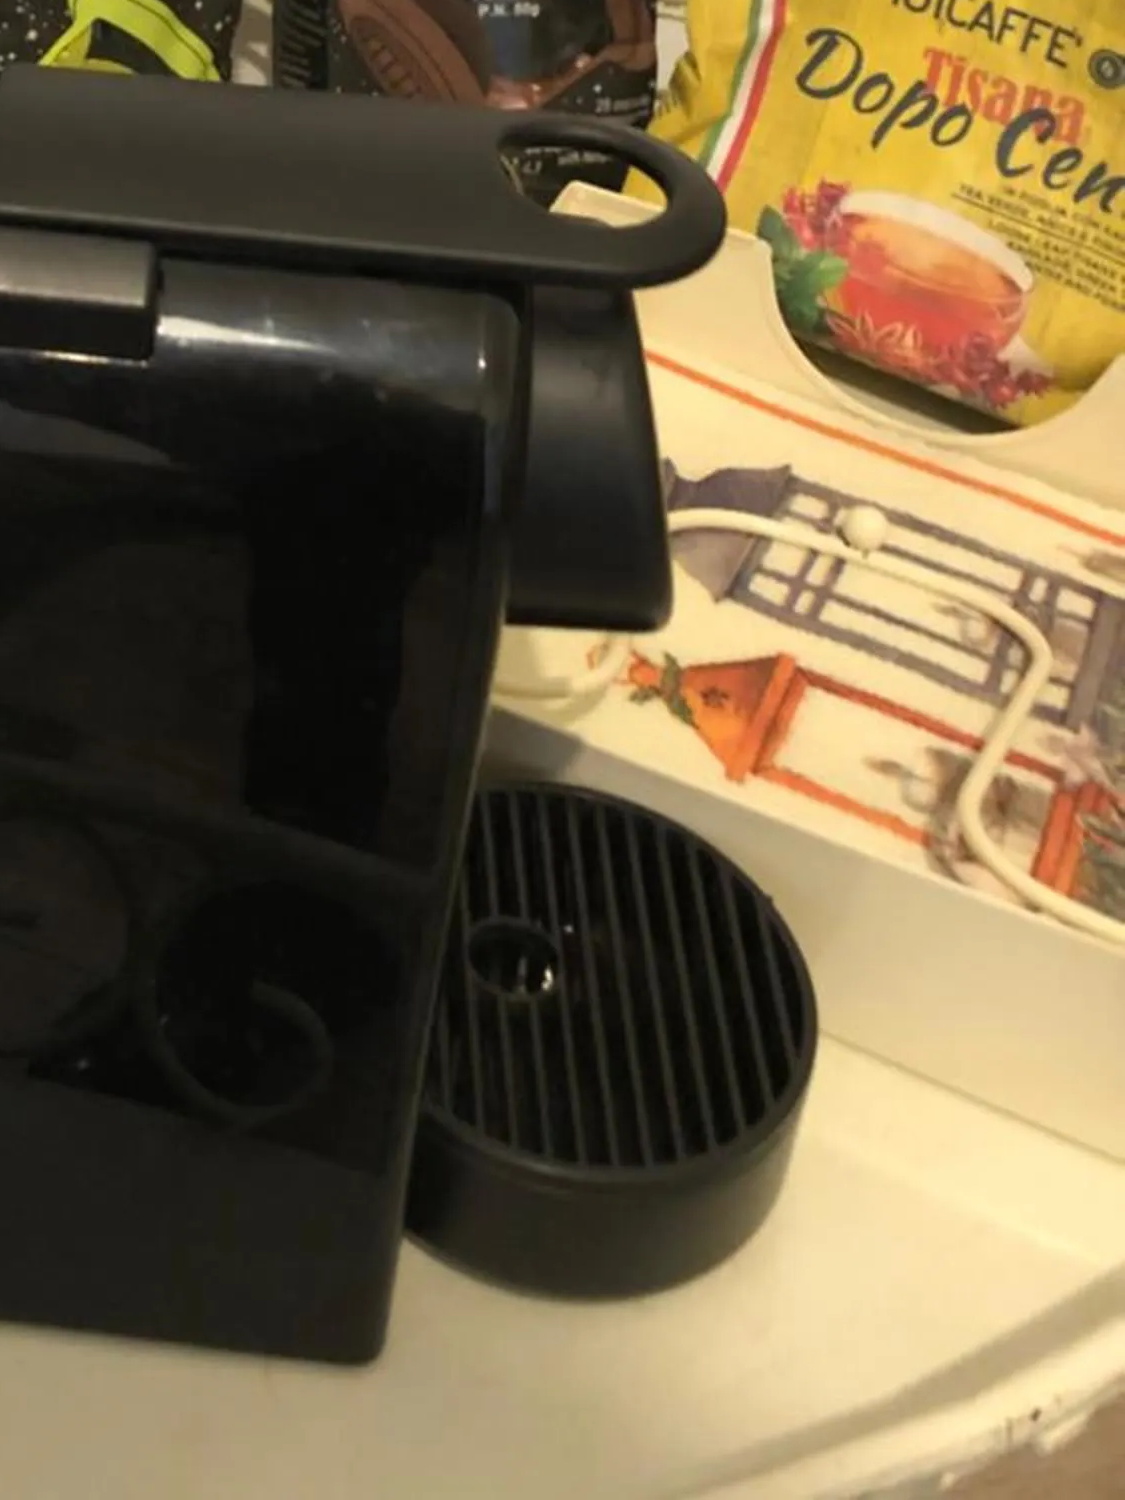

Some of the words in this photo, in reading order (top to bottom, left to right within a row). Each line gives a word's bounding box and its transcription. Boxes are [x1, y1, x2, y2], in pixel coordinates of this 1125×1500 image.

[795, 27, 974, 150] Dopo
[994, 107, 1125, 214] Cen
[923, 46, 1086, 148] Tisana
